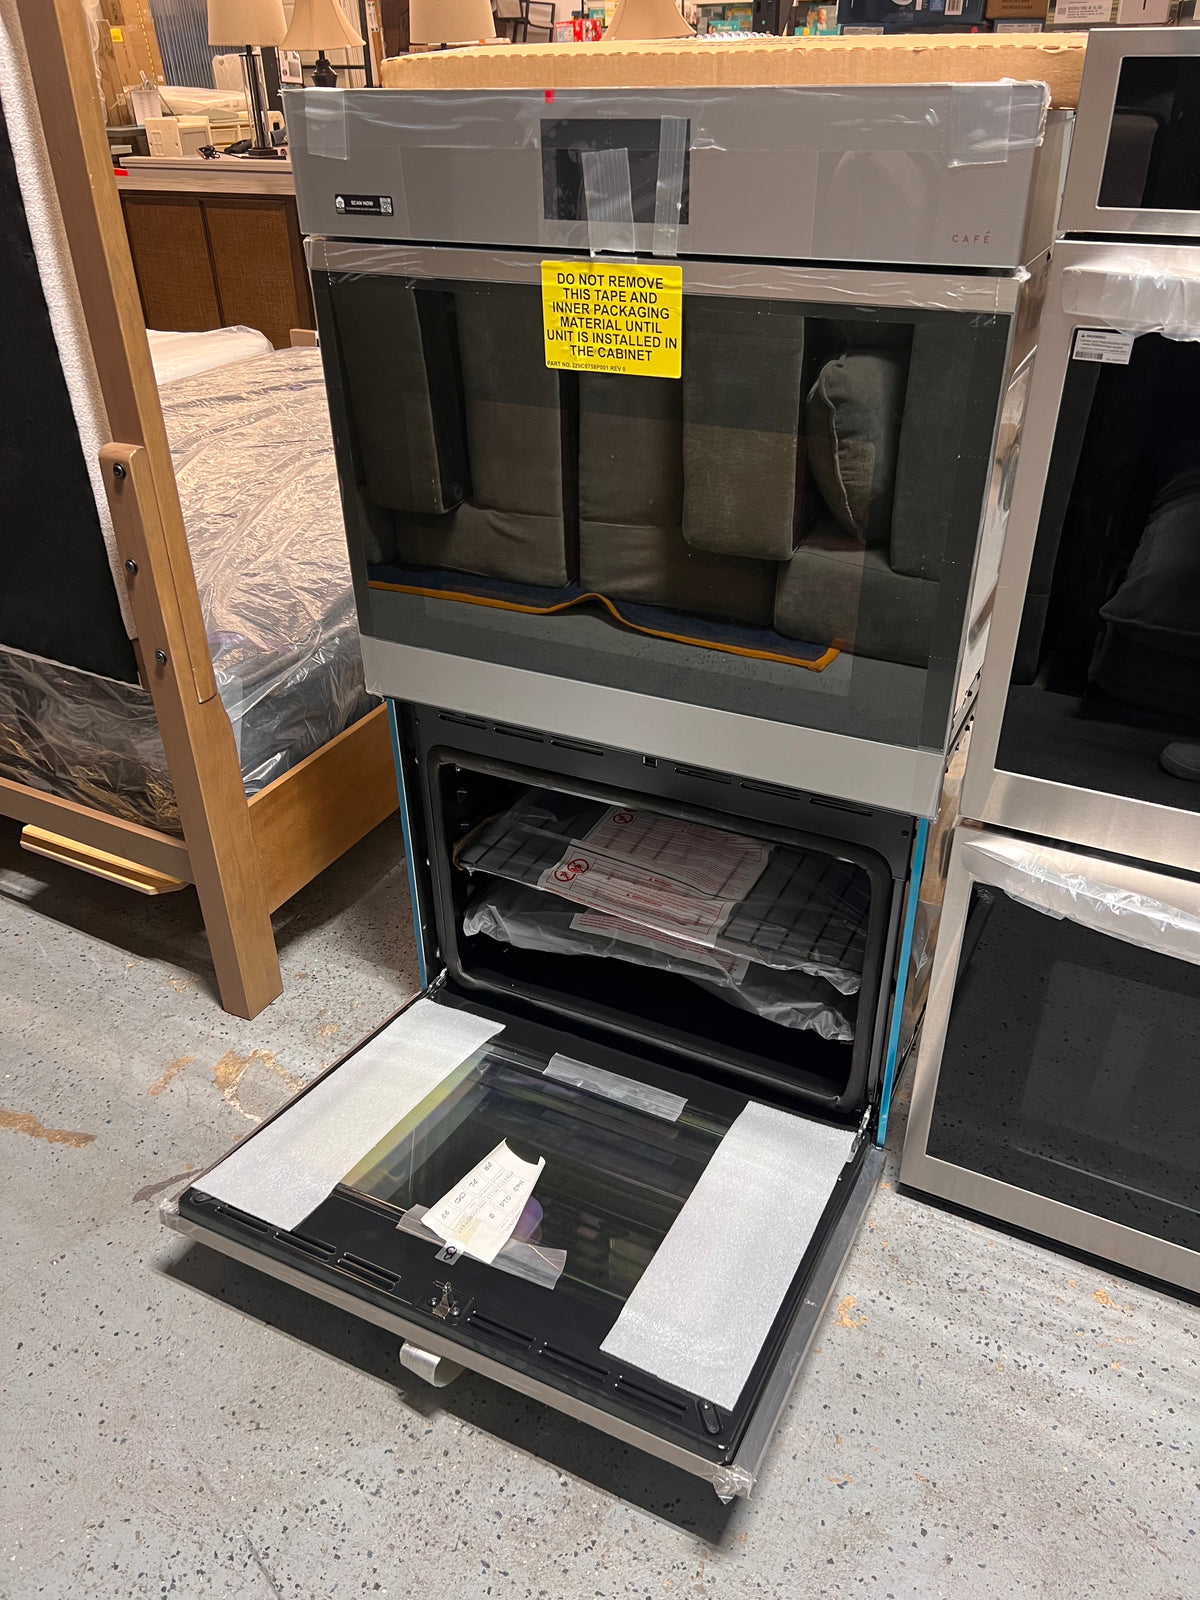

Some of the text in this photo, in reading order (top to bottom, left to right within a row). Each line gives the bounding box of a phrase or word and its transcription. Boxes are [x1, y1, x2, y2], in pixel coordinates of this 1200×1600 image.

[952, 230, 991, 244] CAFÉ
[557, 272, 664, 290] DO NOT REMOVE
[562, 287, 658, 305] THIS TAPE AND
[552, 301, 670, 320] INNER PACKAGING
[560, 316, 663, 334] MATERIAL UNTIL
[547, 329, 678, 349] UNIT IS INSTALLED IN
[570, 344, 653, 361] THE CABINET
